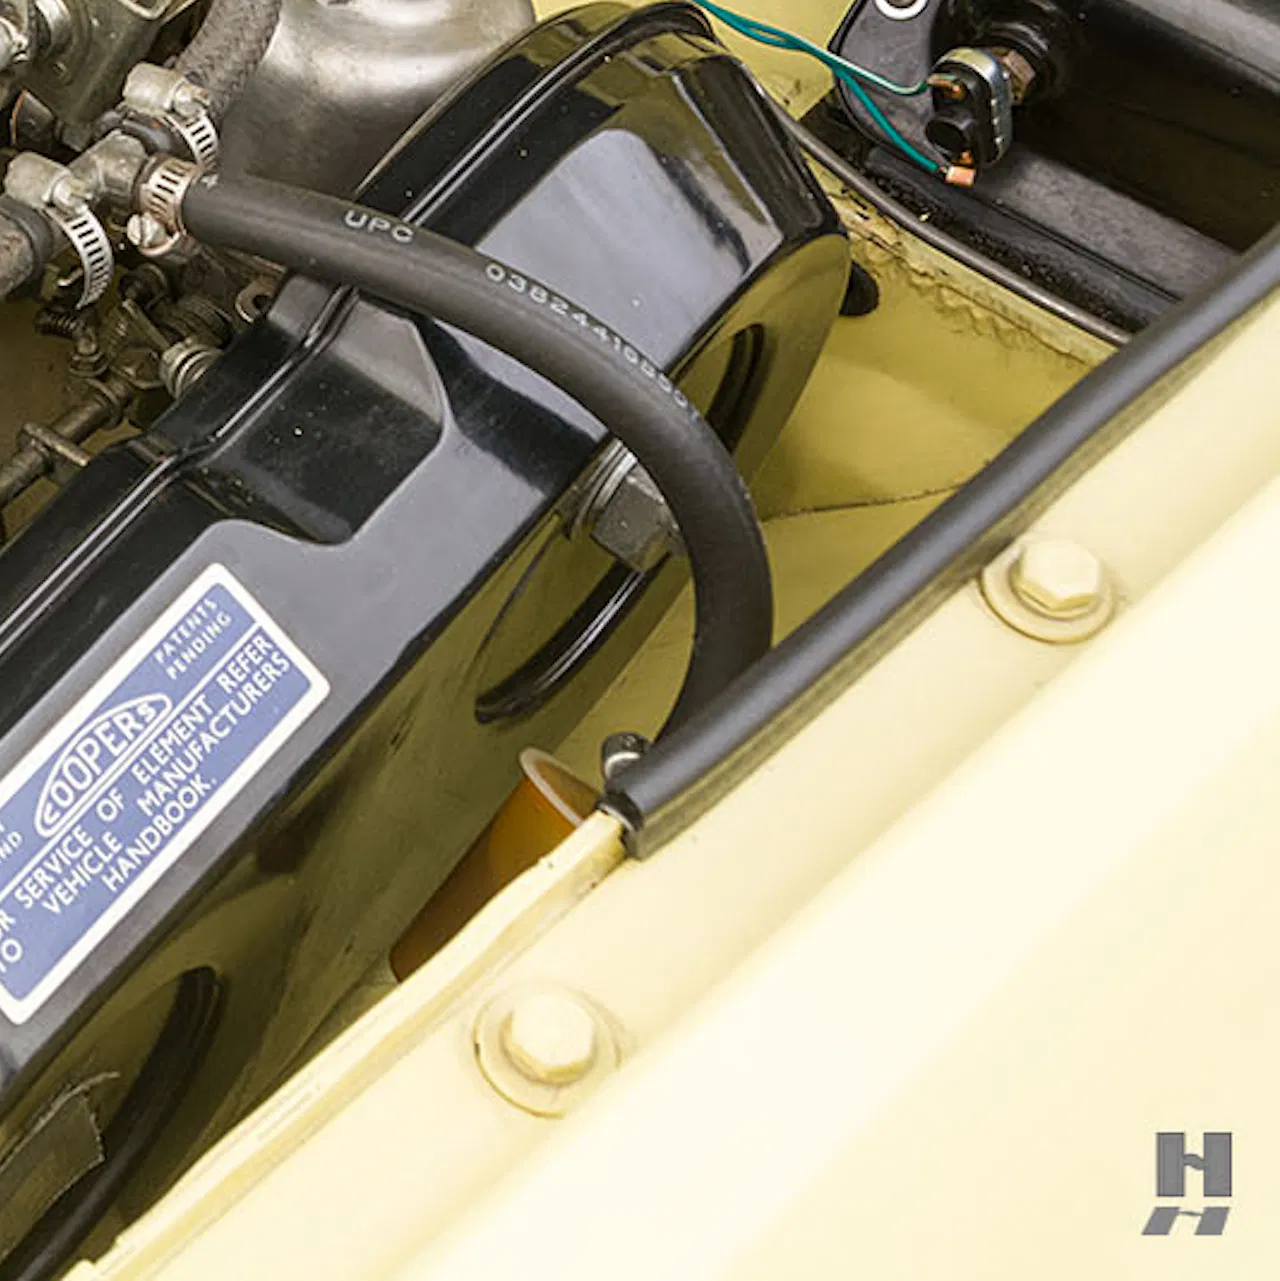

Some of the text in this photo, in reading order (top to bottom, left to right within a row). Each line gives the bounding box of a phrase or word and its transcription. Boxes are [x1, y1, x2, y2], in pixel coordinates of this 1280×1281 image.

[345, 210, 413, 243] UPC
[154, 598, 217, 664] PATENTS
[166, 611, 231, 680] PENDING
[14, 825, 93, 909] SERVICE
[96, 787, 124, 822] OF
[131, 694, 212, 784] ELEMENT
[216, 635, 274, 694] REFER
[38, 700, 159, 828] COOPERS
[42, 831, 122, 913] VEHICLE
[137, 652, 289, 816] MANUFACTURERS
[102, 774, 216, 891] HANDBOOK.
